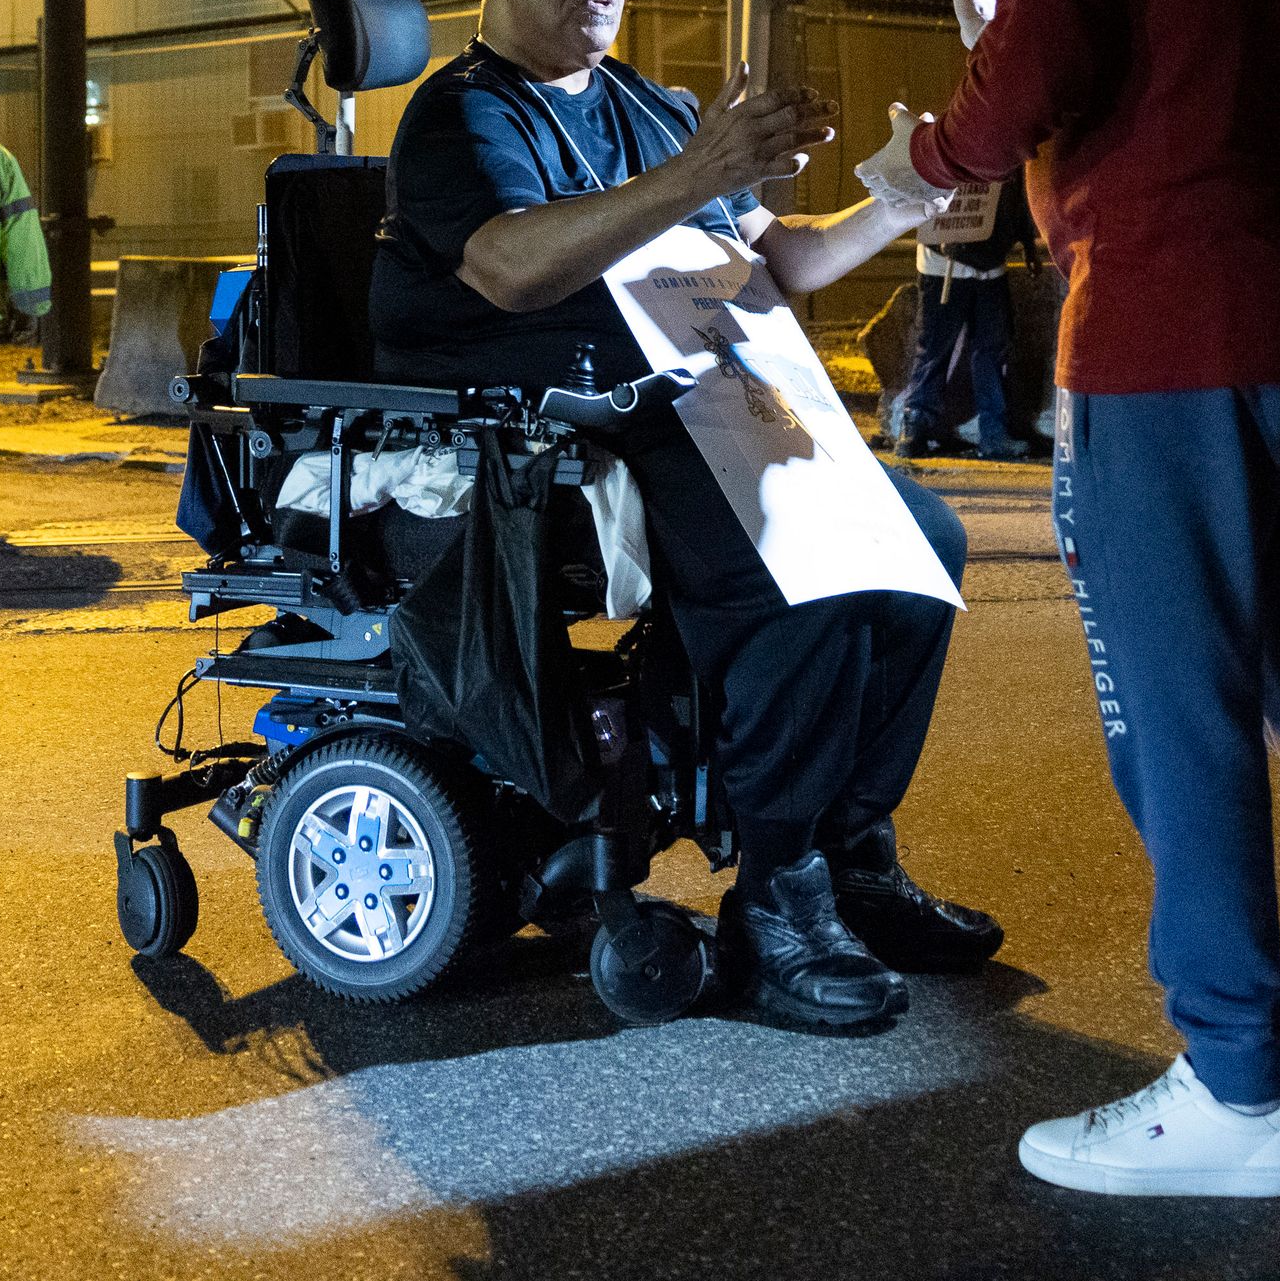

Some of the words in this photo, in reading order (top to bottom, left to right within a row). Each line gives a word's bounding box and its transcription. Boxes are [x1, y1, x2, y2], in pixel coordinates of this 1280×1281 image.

[932, 215, 983, 232] PROTECTION
[652, 276, 699, 289] COMING
[1071, 578, 1127, 739] HILFIGER
